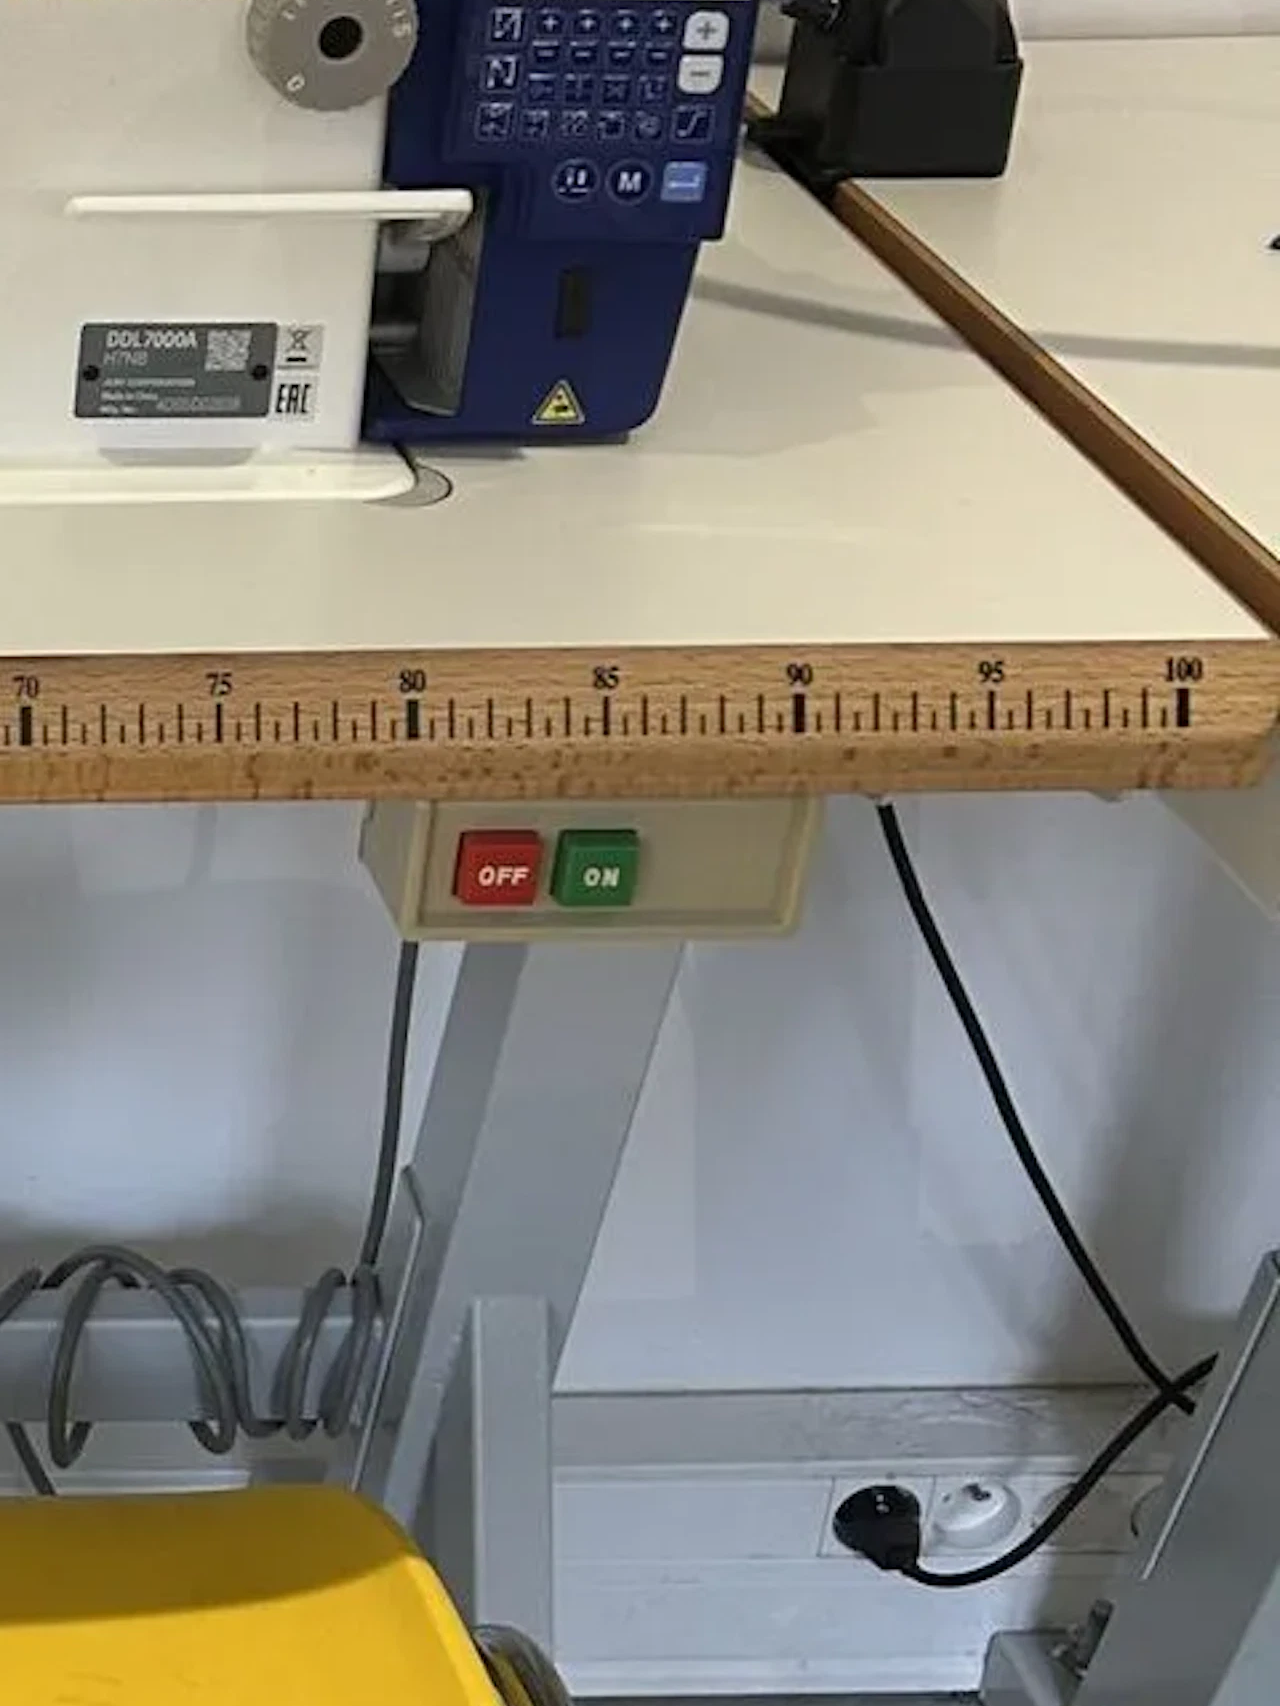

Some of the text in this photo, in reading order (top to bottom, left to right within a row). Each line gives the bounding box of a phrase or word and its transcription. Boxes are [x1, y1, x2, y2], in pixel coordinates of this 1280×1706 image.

[617, 170, 643, 193] M
[275, 383, 311, 415] EAC
[13, 675, 39, 699] 70
[206, 672, 232, 696] 75
[399, 669, 426, 693] 80
[592, 666, 619, 690] 85
[786, 663, 813, 687] 90
[978, 660, 1006, 684] 95
[1164, 657, 1203, 682] 100
[477, 864, 621, 887] OFF ON
